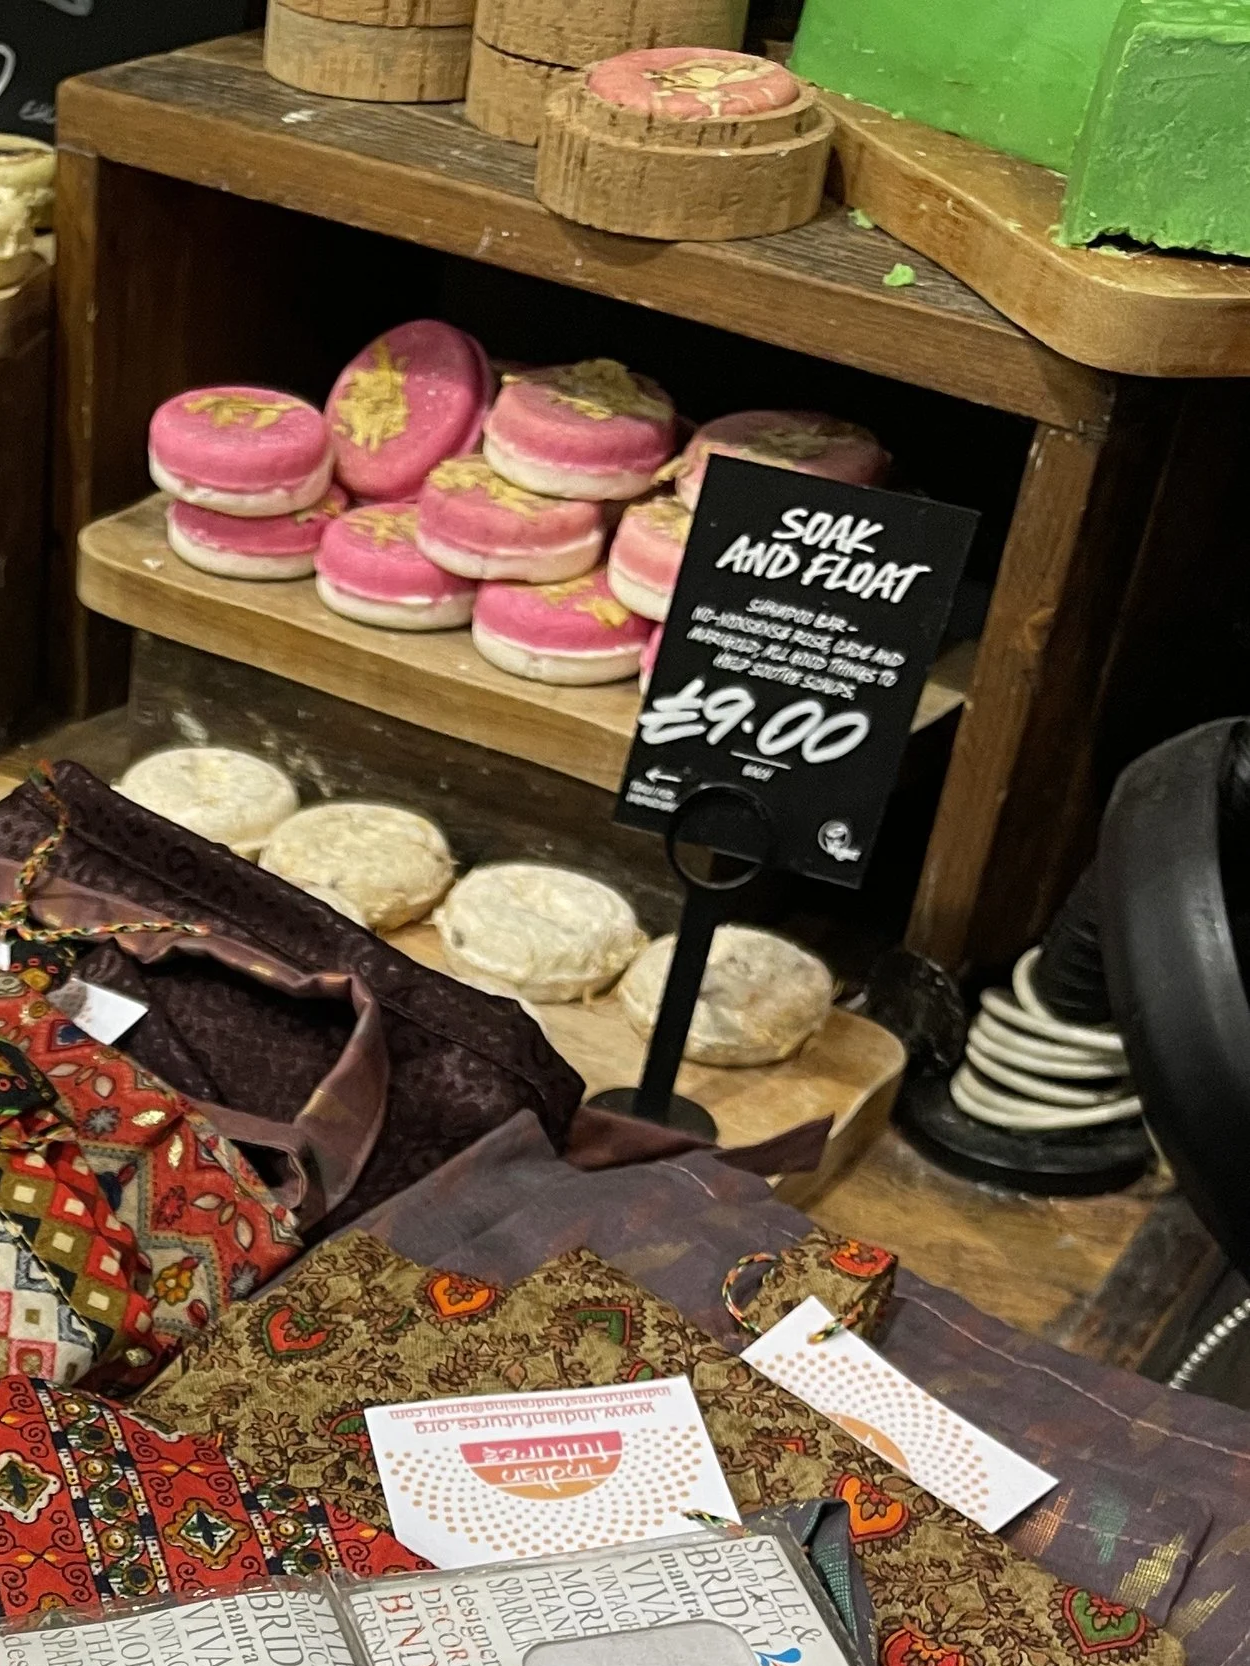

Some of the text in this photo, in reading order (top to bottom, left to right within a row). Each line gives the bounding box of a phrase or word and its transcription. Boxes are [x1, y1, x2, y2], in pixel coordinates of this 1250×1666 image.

[772, 508, 884, 554] SOAK
[715, 534, 933, 603] AND FLOAT
[637, 676, 870, 764] £9.00
[413, 1403, 655, 1435] www.indianfutures.org
[501, 1461, 599, 1492] indian
[624, 1558, 680, 1627] VIVA
[658, 1552, 704, 1619] mantra
[744, 1540, 822, 1644] STYLE &
[221, 1599, 259, 1664] mantra
[450, 1584, 502, 1666] designer
